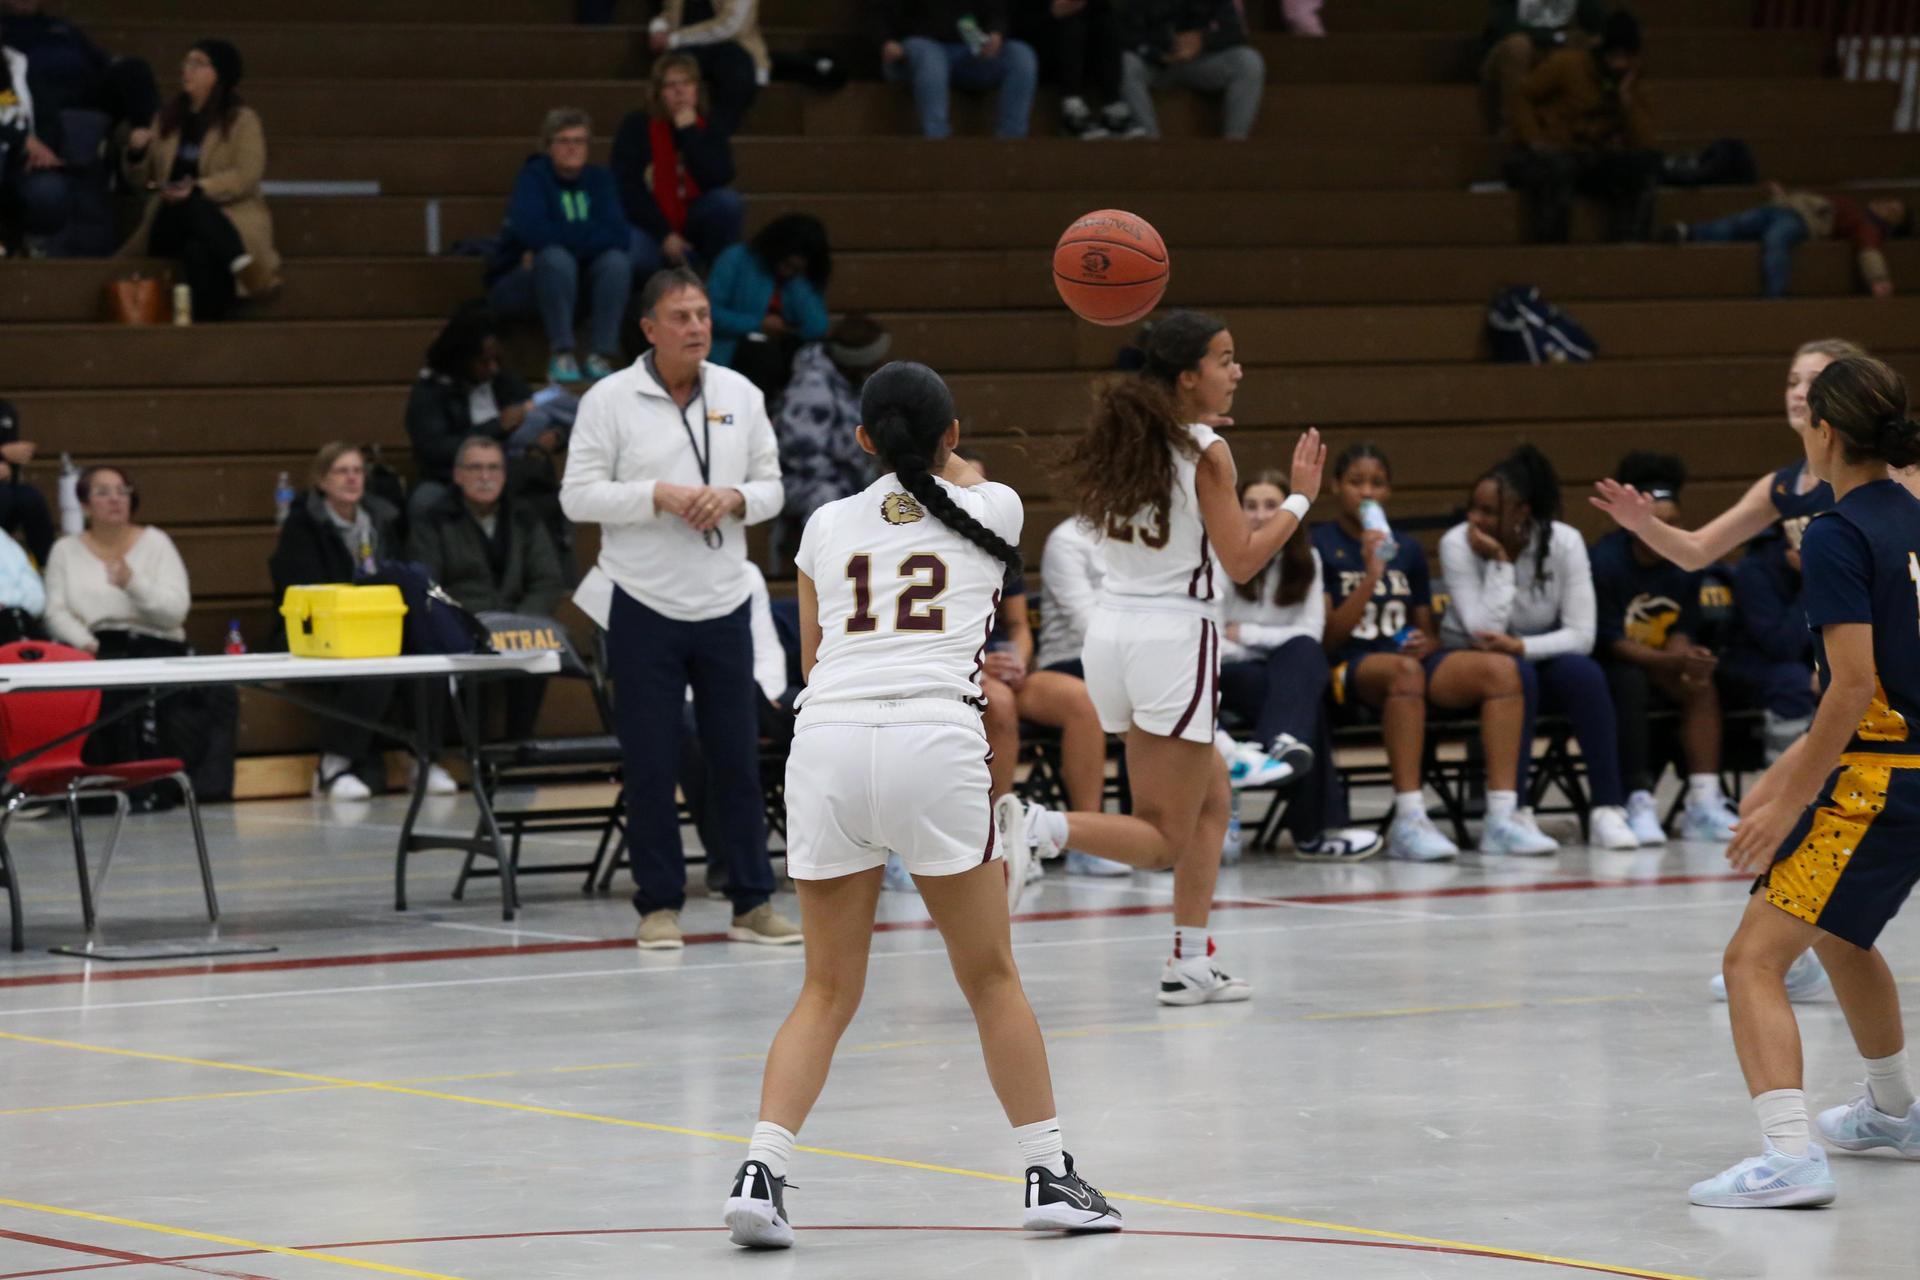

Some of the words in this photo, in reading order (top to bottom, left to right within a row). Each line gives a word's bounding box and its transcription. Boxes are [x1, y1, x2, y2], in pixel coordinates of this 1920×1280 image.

[1071, 217, 1144, 241] SPAL
[844, 552, 949, 634] 12
[490, 627, 562, 652] NTRAL
